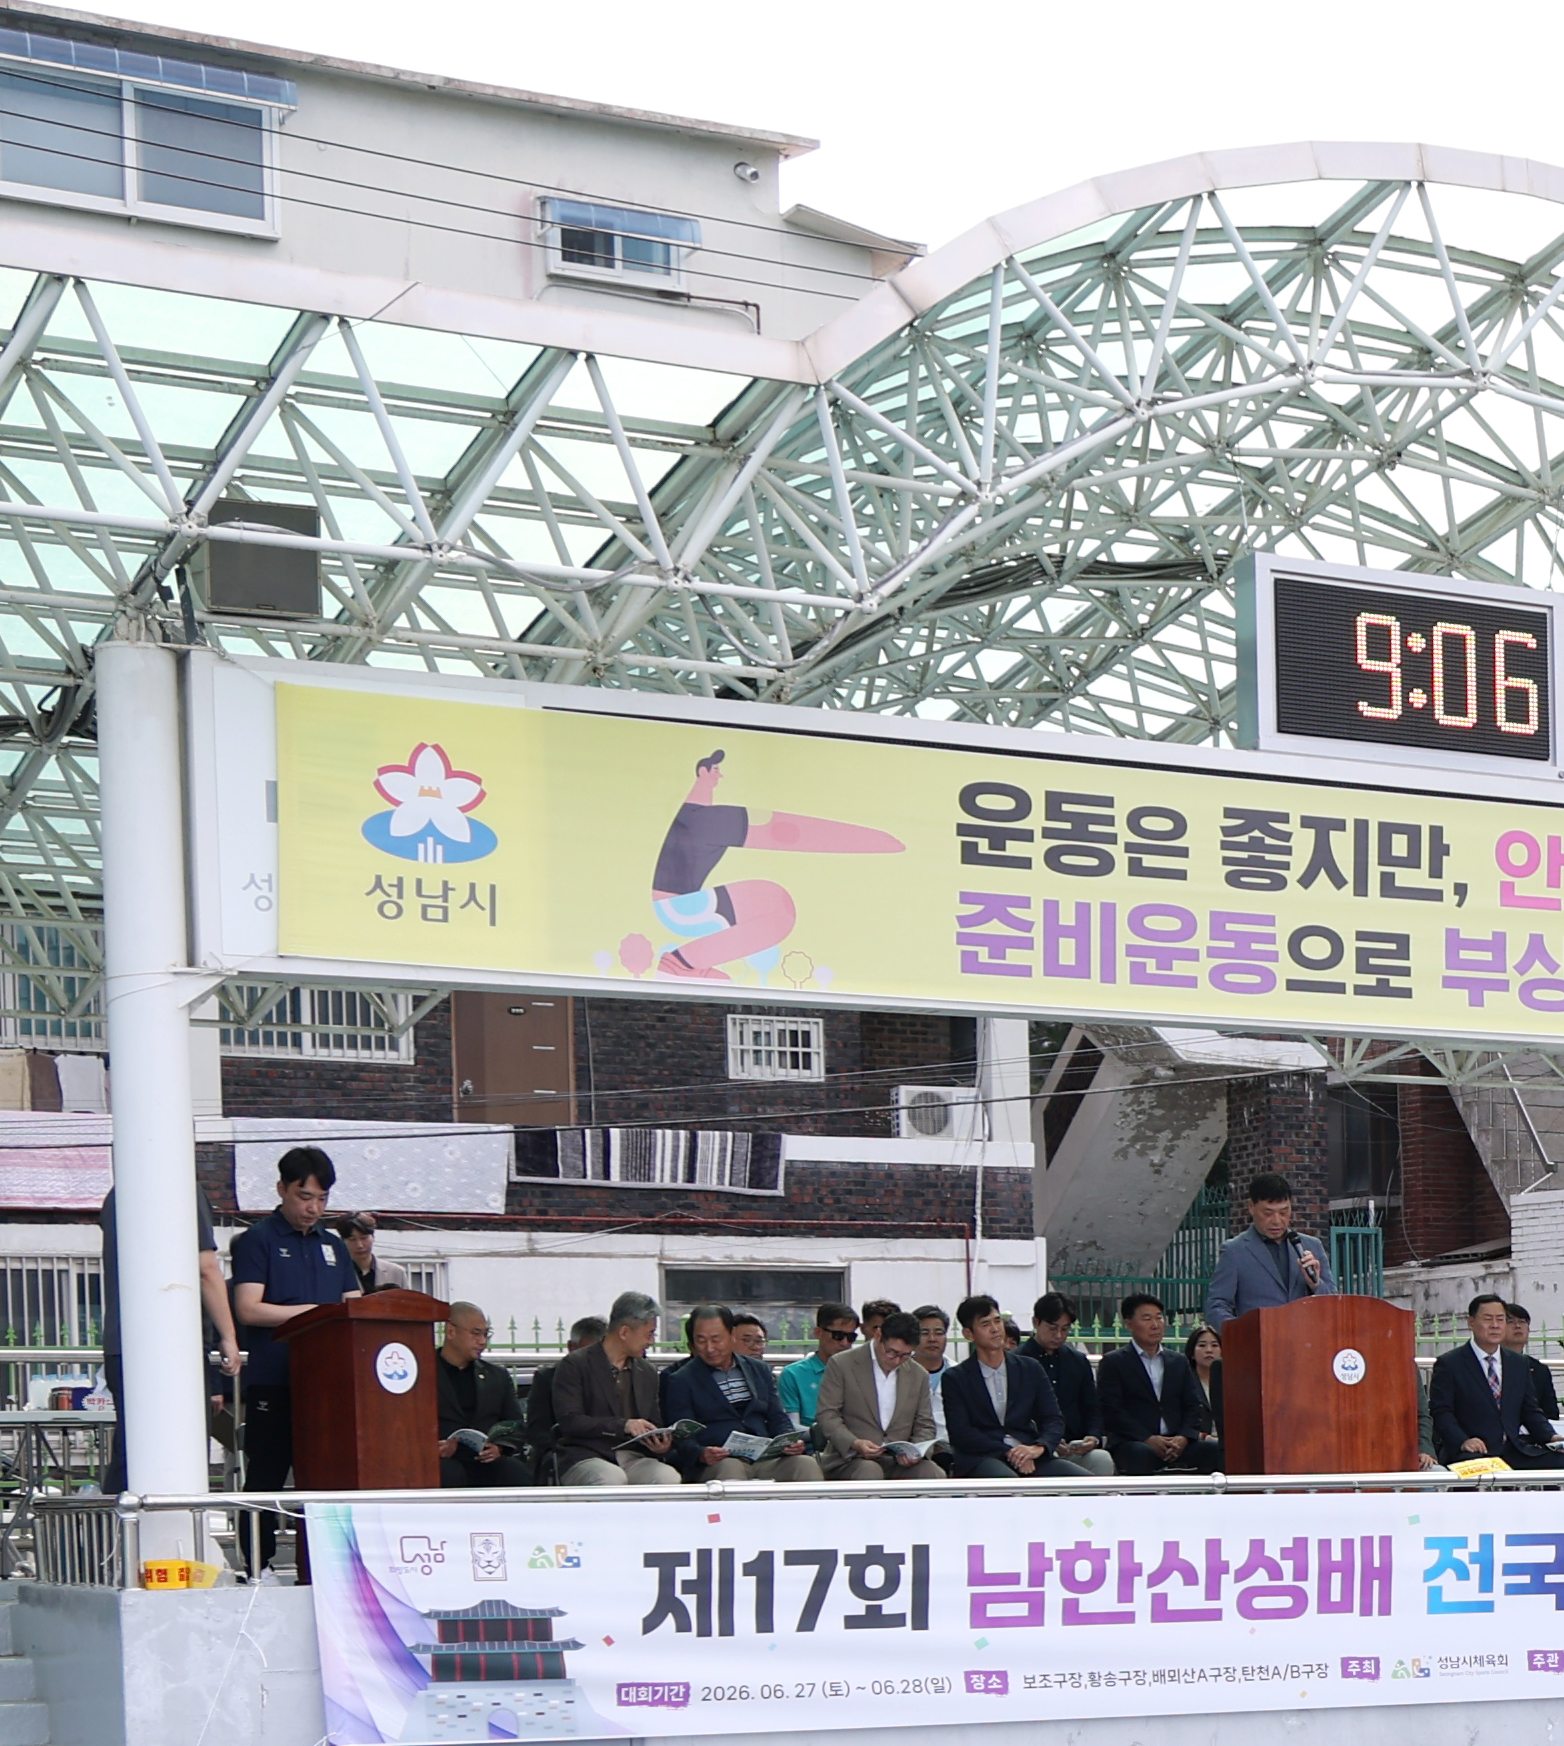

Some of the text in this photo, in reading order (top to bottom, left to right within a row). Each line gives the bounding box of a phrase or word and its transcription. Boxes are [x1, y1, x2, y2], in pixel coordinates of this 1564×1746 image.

[1355, 611, 1539, 736] 9:06
[956, 781, 1190, 881] 운동은
[1219, 807, 1469, 908] 좋지만,
[364, 873, 497, 927] 성남시
[955, 890, 1412, 1000] 준비운동으로
[641, 1543, 930, 1638] 제17회
[965, 1535, 1394, 1629] 남한산성배
[969, 1674, 1003, 1691] 장소
[1346, 1654, 1509, 1676] 주최 성남시체육회
[1532, 1653, 1560, 1669] 주관
[620, 1685, 686, 1704] 대회기간
[701, 1685, 755, 1702] 2026.
[760, 1685, 789, 1700] 06.
[794, 1683, 816, 1699] 27
[871, 1676, 953, 1696] 06.28(일)
